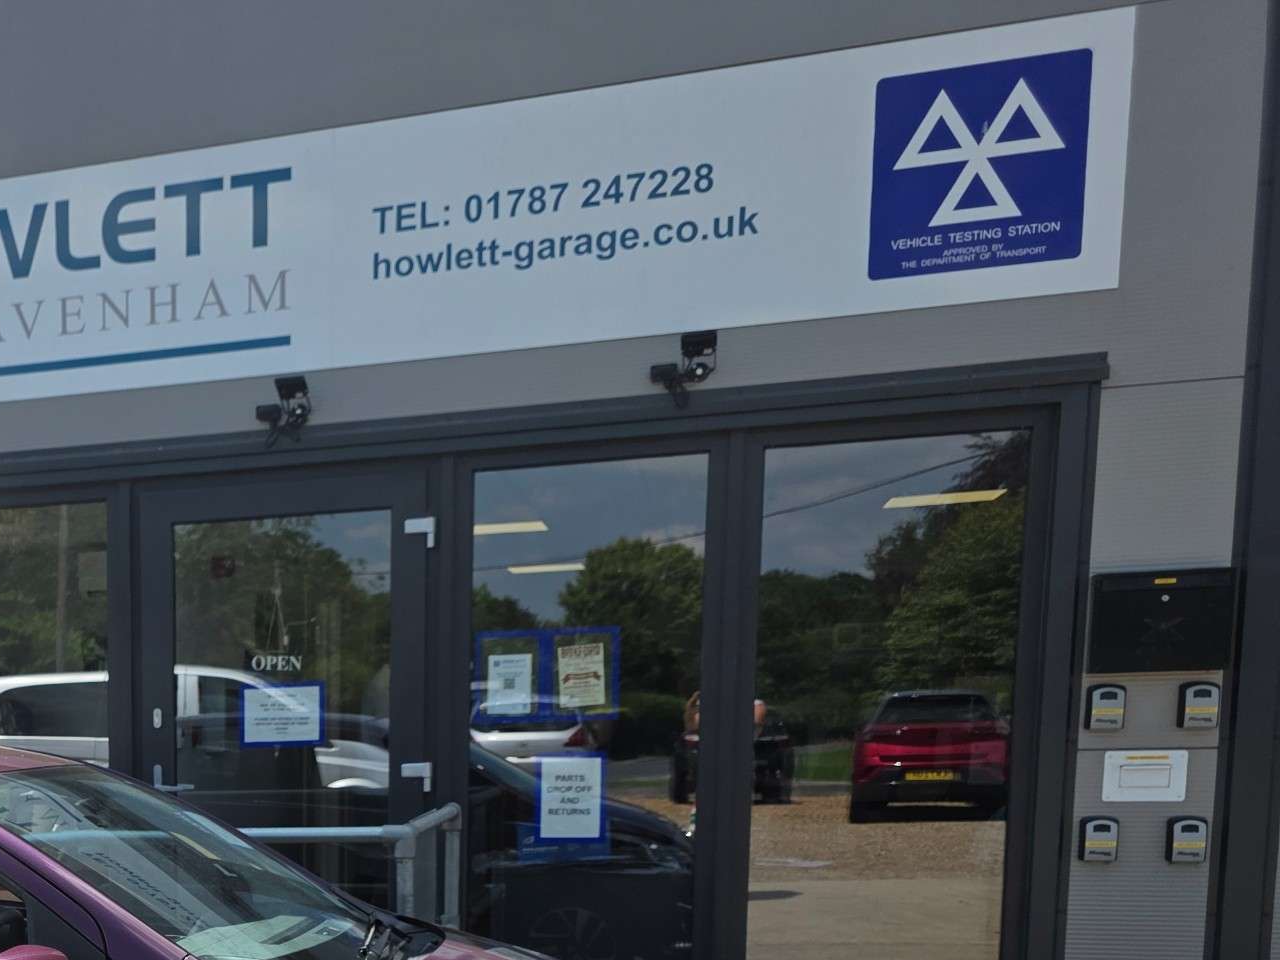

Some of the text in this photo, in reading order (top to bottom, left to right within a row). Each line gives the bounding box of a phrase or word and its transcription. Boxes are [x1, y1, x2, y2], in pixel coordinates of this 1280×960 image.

[372, 163, 714, 235] TEL: 01787 247228
[372, 206, 759, 280] howlett-garage.co.uk
[891, 221, 1061, 250] VEHICLE TESTING STATION
[901, 245, 1047, 270] THE DEPARTMENT OF TRANSPORT
[942, 243, 1004, 257] APPROVED BY
[251, 655, 303, 671] OPEN
[554, 774, 586, 783] PARTS
[574, 785, 593, 793] OFF
[559, 796, 580, 805] AND
[547, 807, 592, 816] RETURNS
